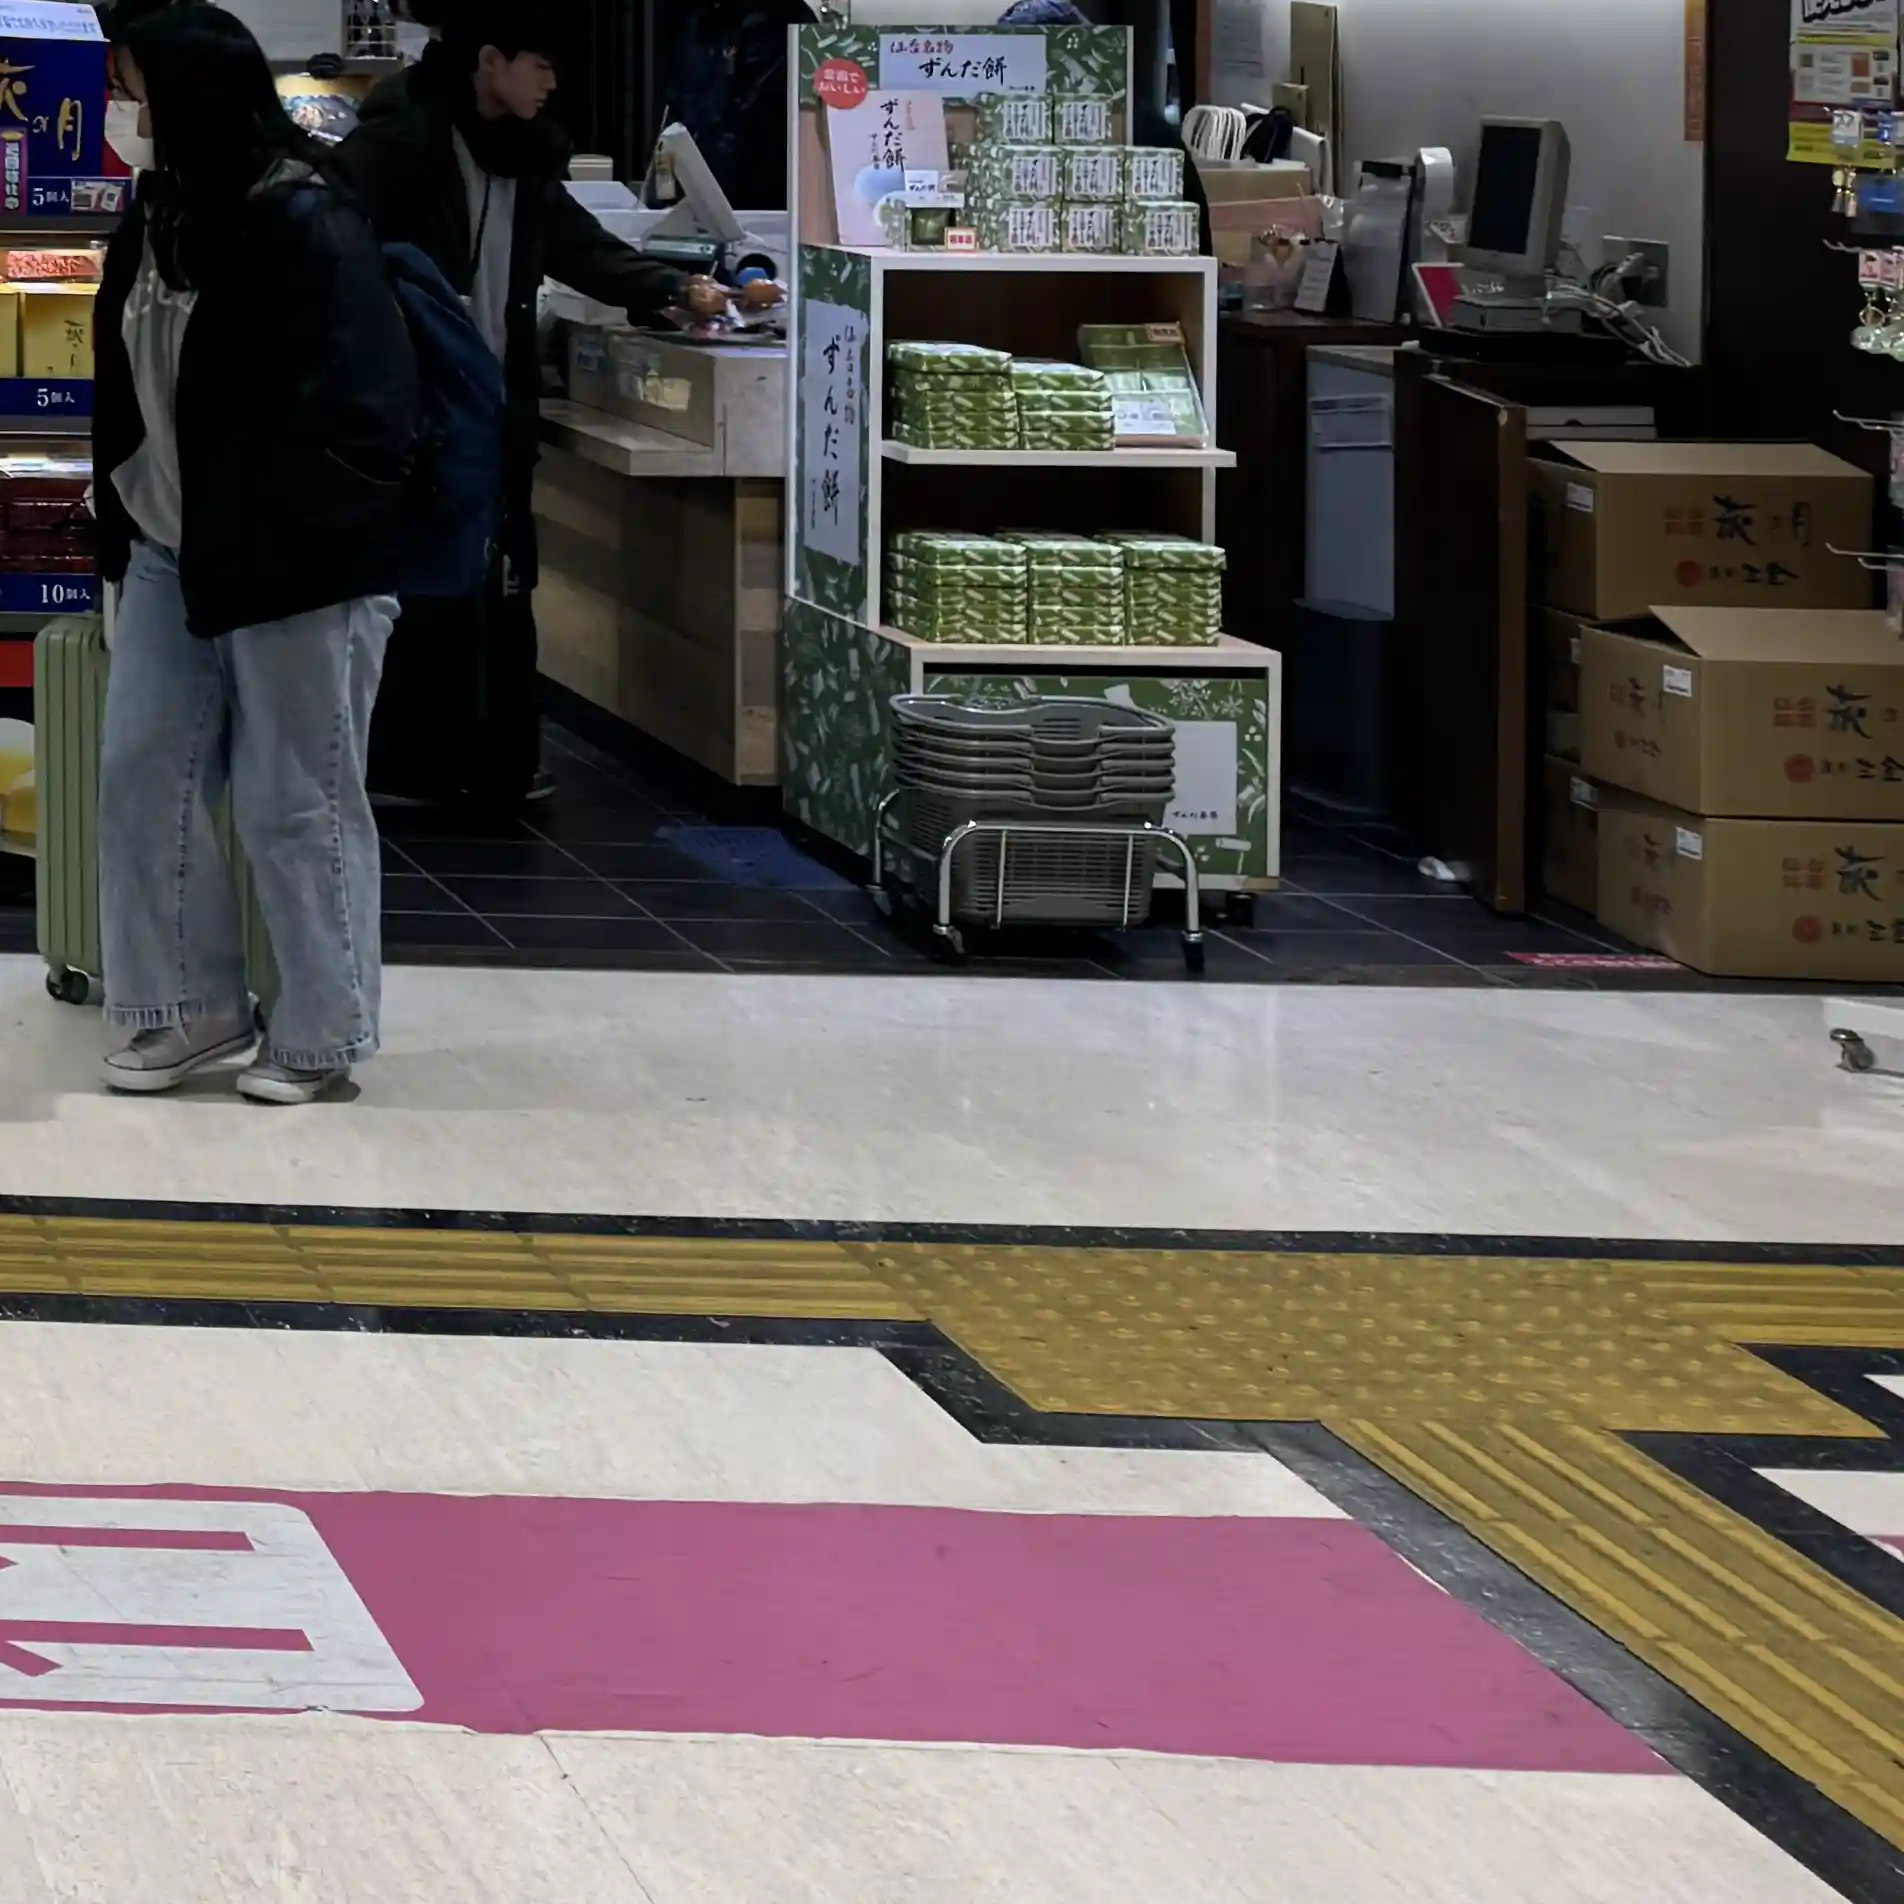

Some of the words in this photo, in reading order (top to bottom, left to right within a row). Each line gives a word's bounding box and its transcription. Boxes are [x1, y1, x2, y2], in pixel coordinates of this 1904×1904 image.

[918, 56, 1008, 85] ずんだ餅
[880, 98, 907, 172] ずんだ餅
[820, 334, 841, 528] ずんだ餅
[40, 583, 92, 605] 10個入
